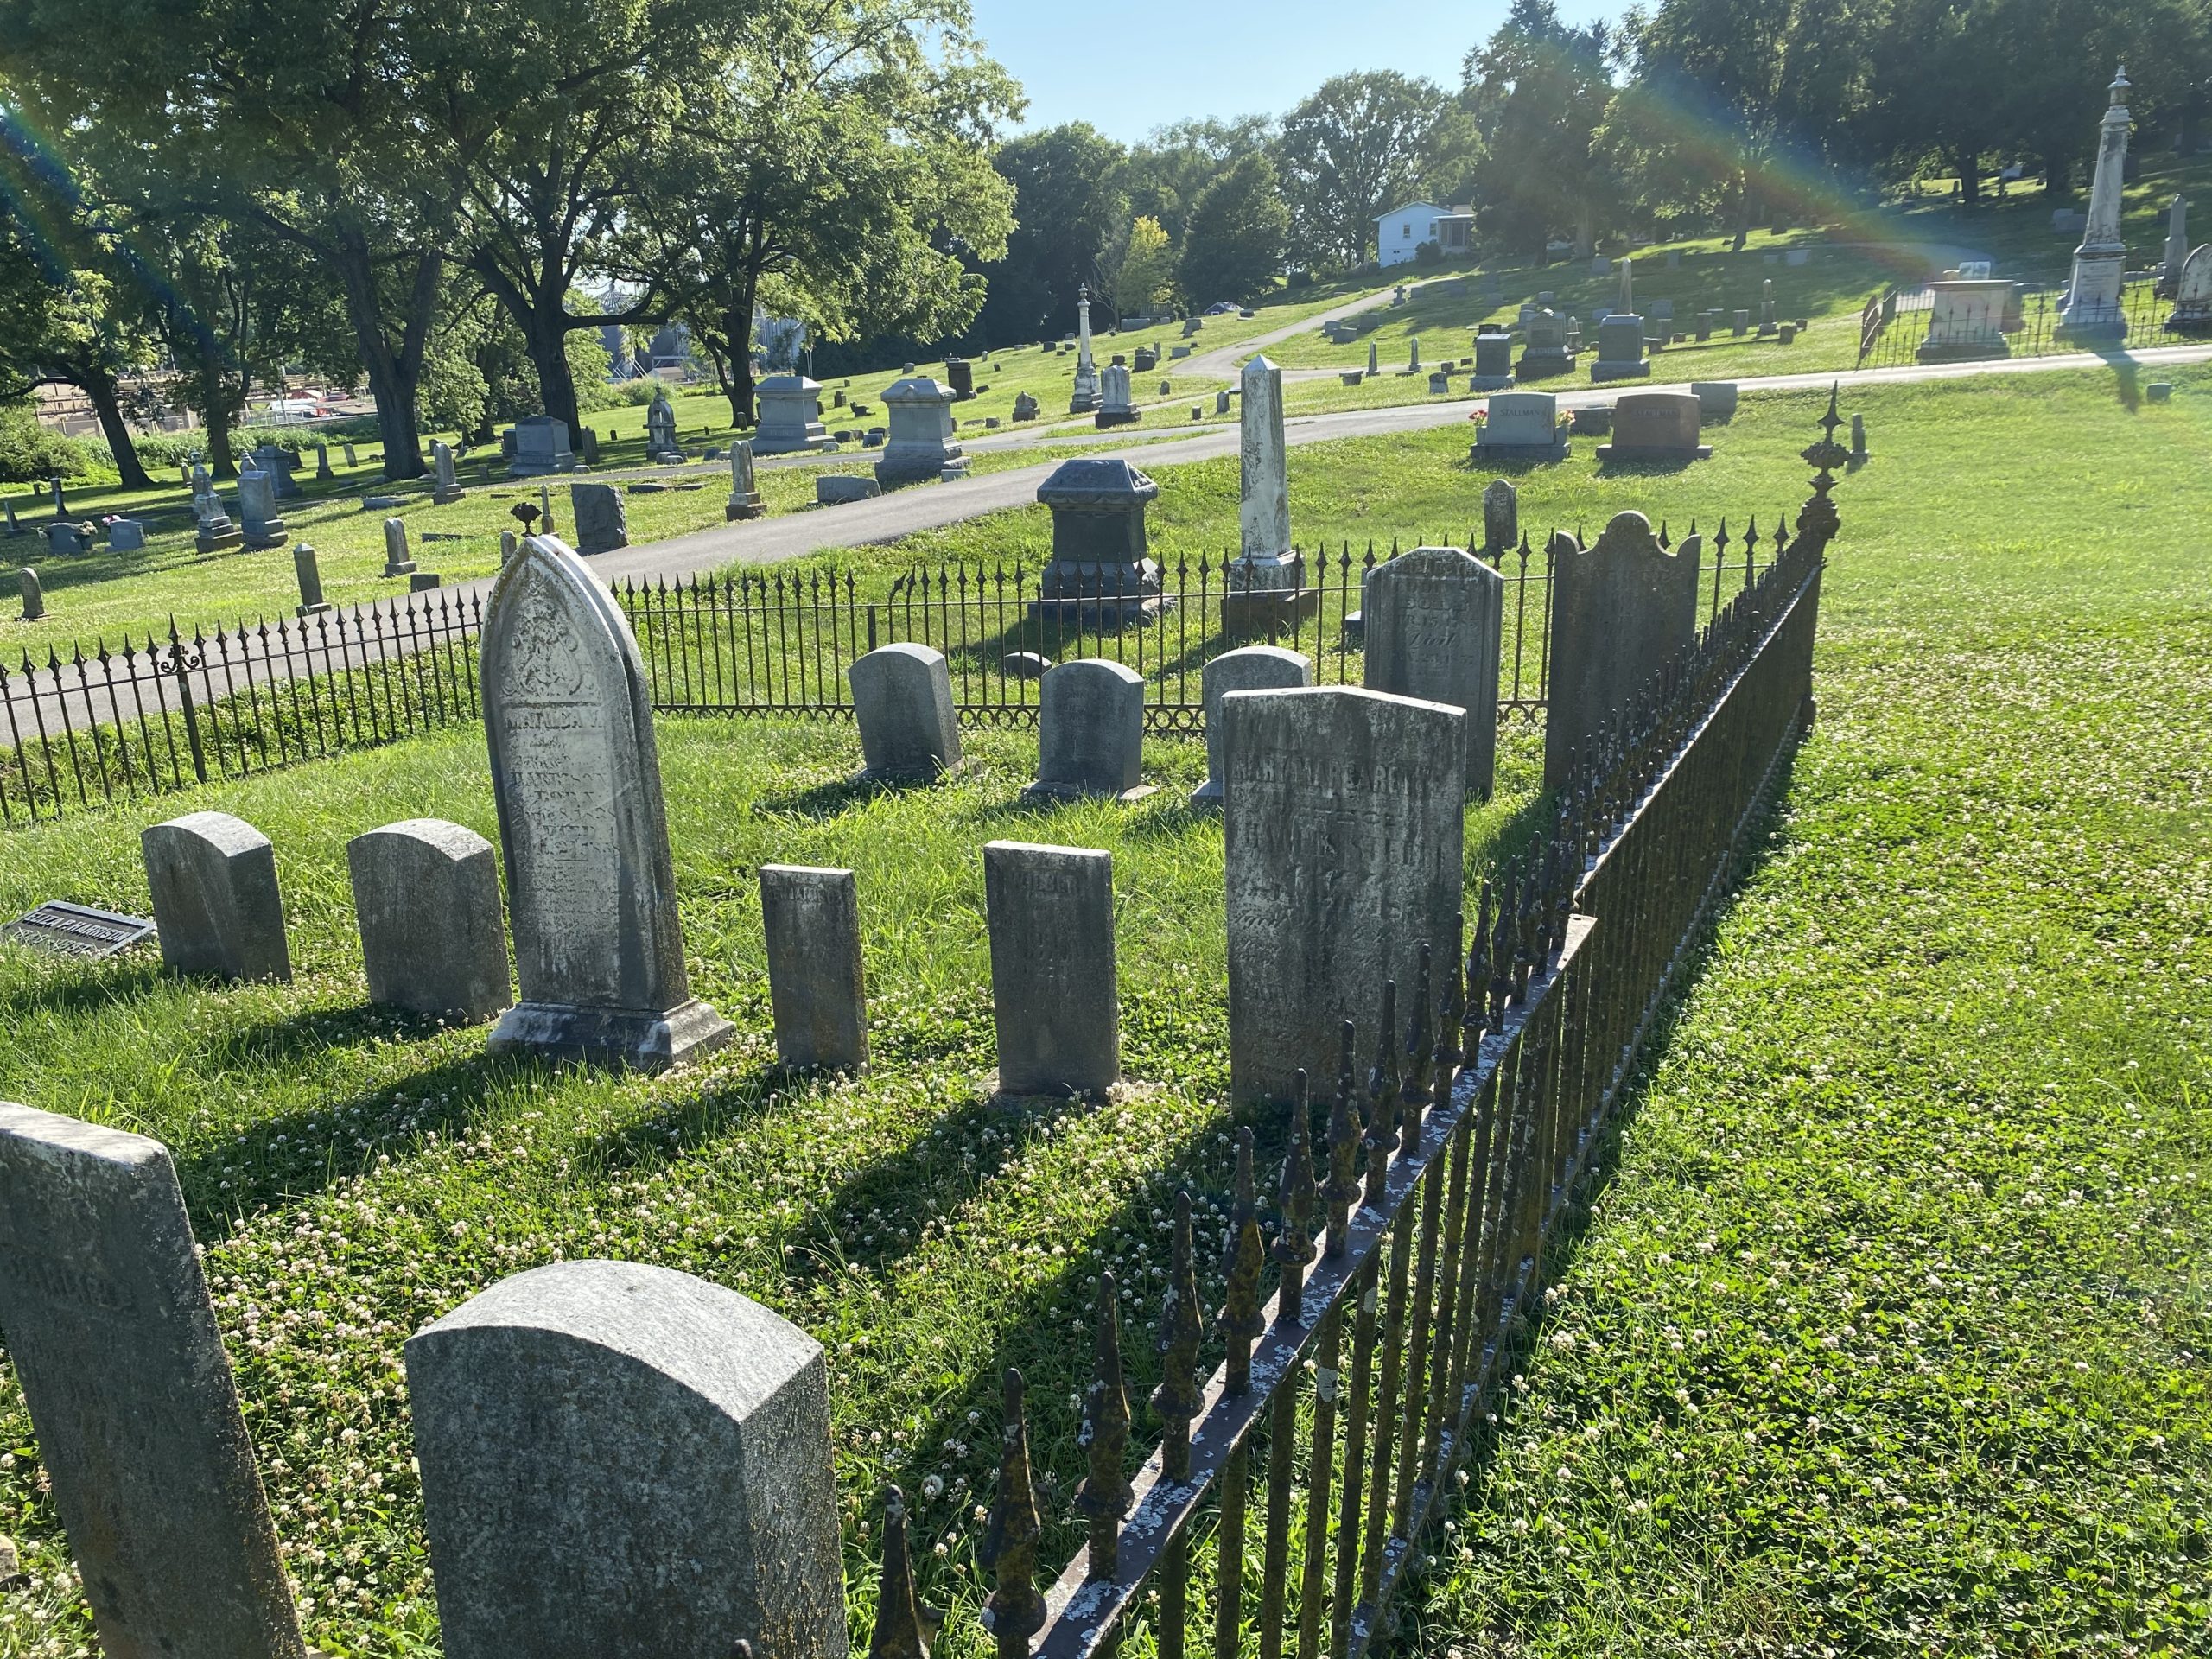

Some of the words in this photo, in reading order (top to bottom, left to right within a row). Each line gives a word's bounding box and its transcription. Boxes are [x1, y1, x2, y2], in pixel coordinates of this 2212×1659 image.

[1499, 408, 1541, 416] STALLMAN
[24, 912, 65, 927] ELIZA
[67, 921, 133, 942] HARRISON
